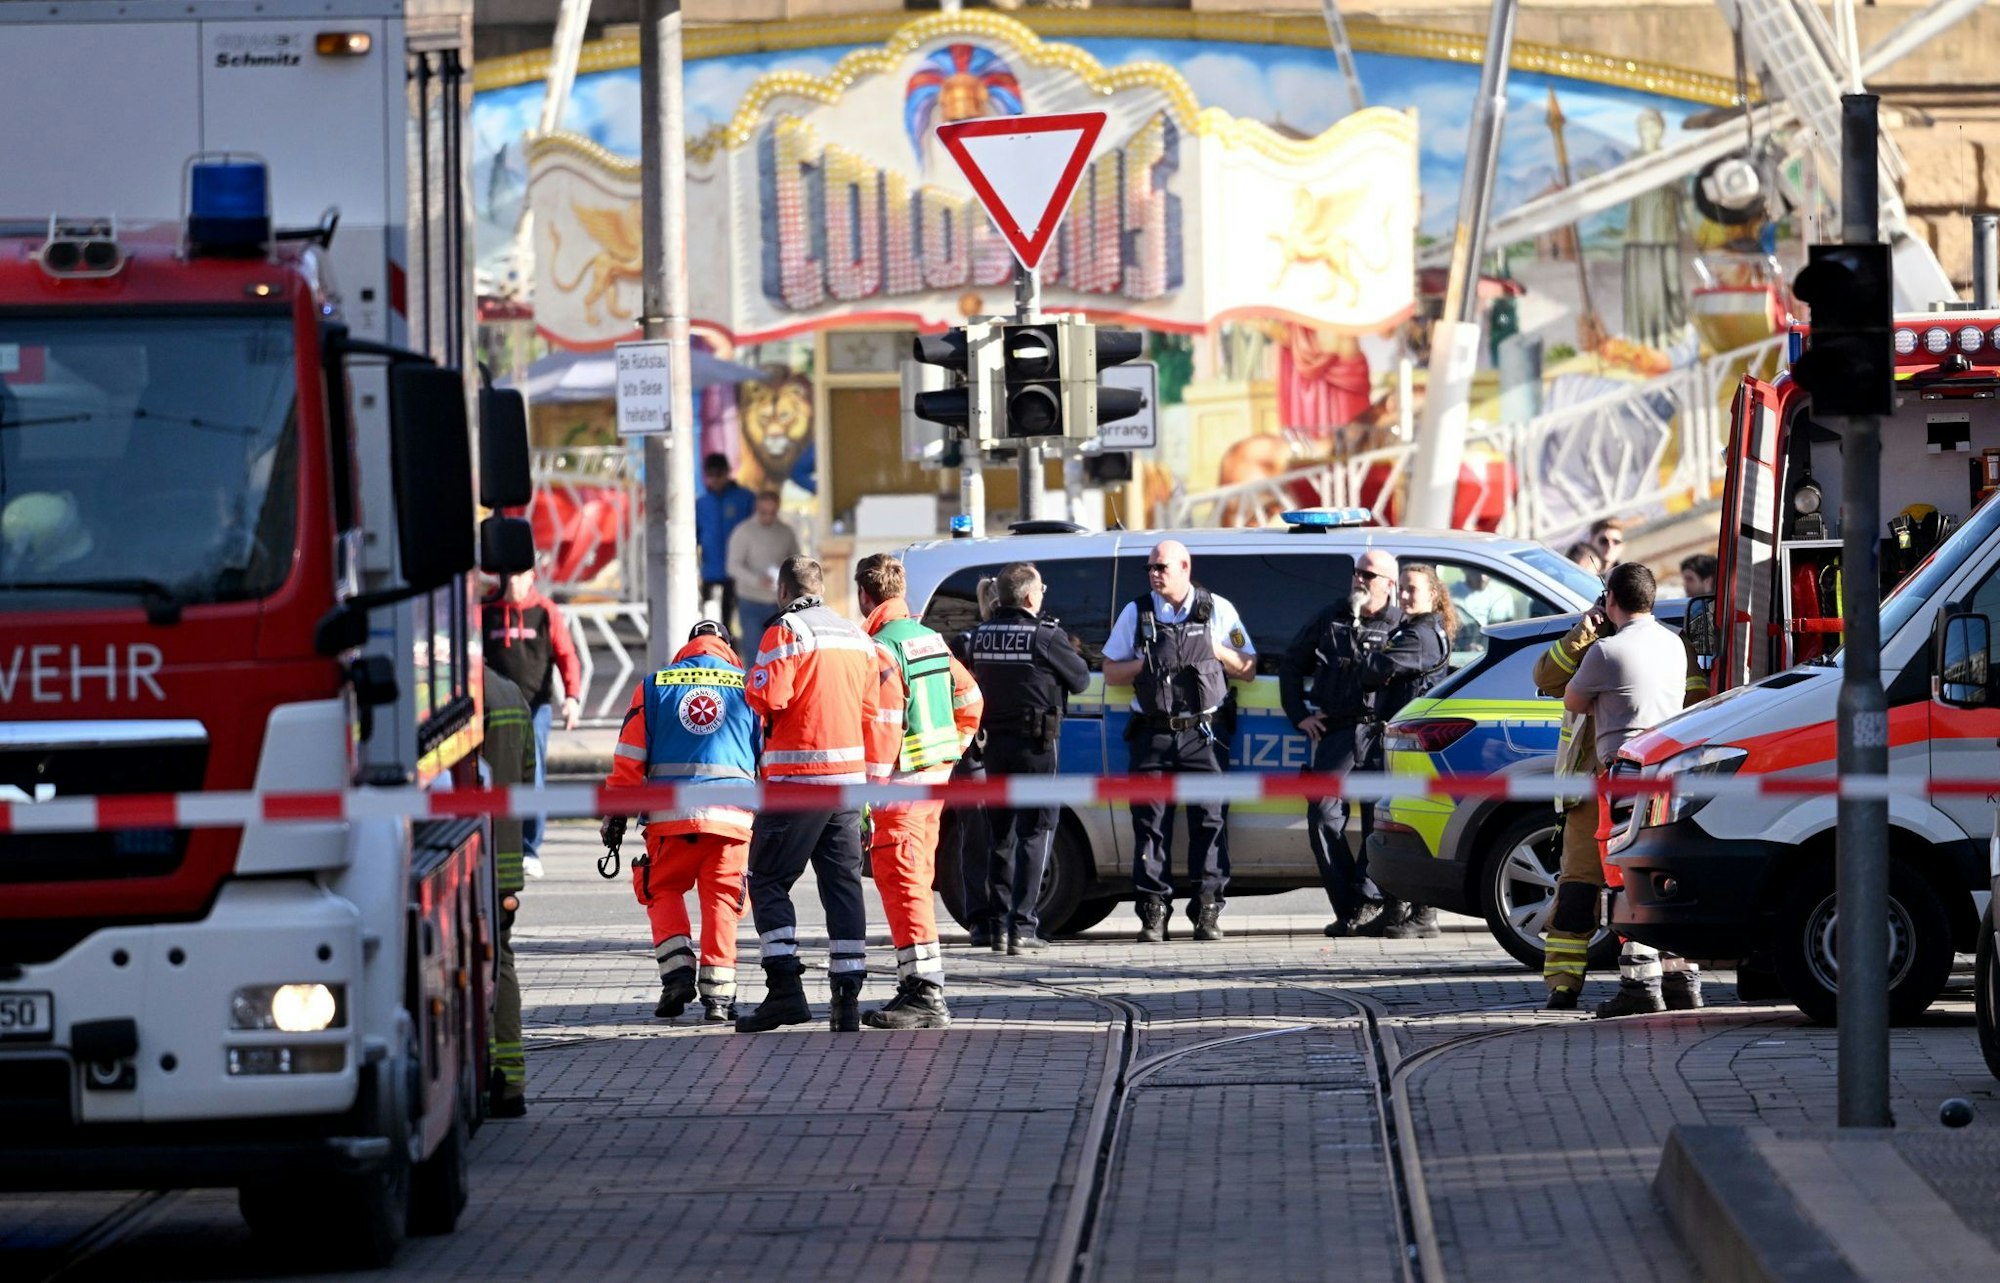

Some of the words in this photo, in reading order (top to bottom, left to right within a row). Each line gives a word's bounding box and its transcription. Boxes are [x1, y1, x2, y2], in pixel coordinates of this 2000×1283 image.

[215, 53, 301, 68] Schmitz
[1098, 425, 1148, 440] orrang
[974, 633, 1031, 651] POLIZEI
[684, 690, 722, 706] JOHANNITER
[681, 714, 722, 733] UNFALL-HILFE
